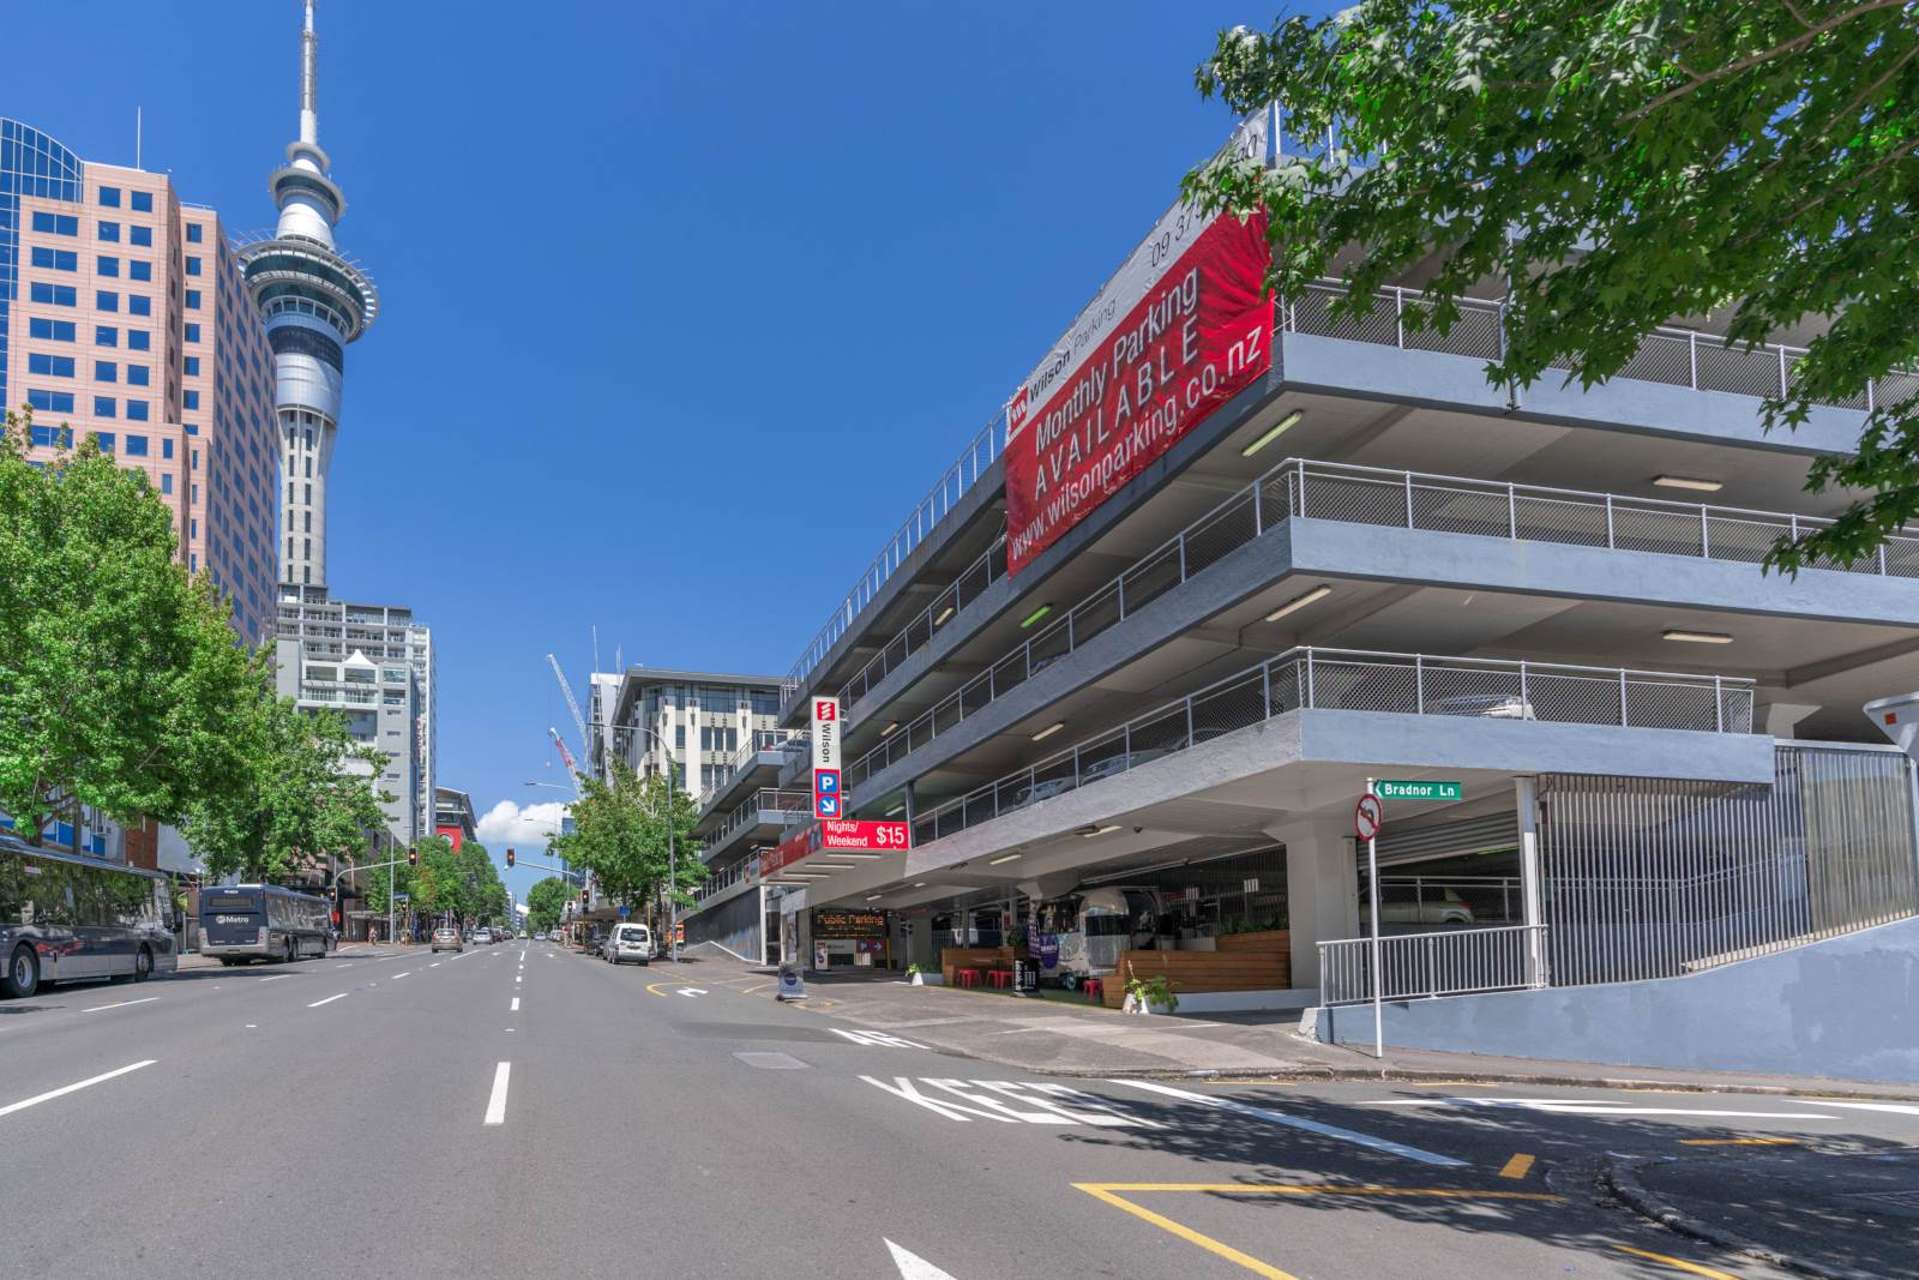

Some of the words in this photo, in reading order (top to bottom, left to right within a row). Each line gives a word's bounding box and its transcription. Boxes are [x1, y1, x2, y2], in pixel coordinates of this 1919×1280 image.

[1029, 349, 1071, 402] Wilson
[1074, 298, 1118, 354] Parking
[1035, 362, 1107, 457] Monthly
[1113, 267, 1198, 379] Parking
[1035, 314, 1198, 500] AVAILABLE
[1012, 325, 1263, 561] www.wilsonparking.co.nz
[822, 723, 832, 763] Wilson
[822, 776, 834, 790] P
[1384, 783, 1432, 796] Bradnor
[1439, 784, 1456, 797] Ln
[827, 821, 859, 834] Nights/
[827, 834, 868, 847] Weekend
[876, 826, 905, 846] $15
[856, 1075, 1172, 1130] KEEP
